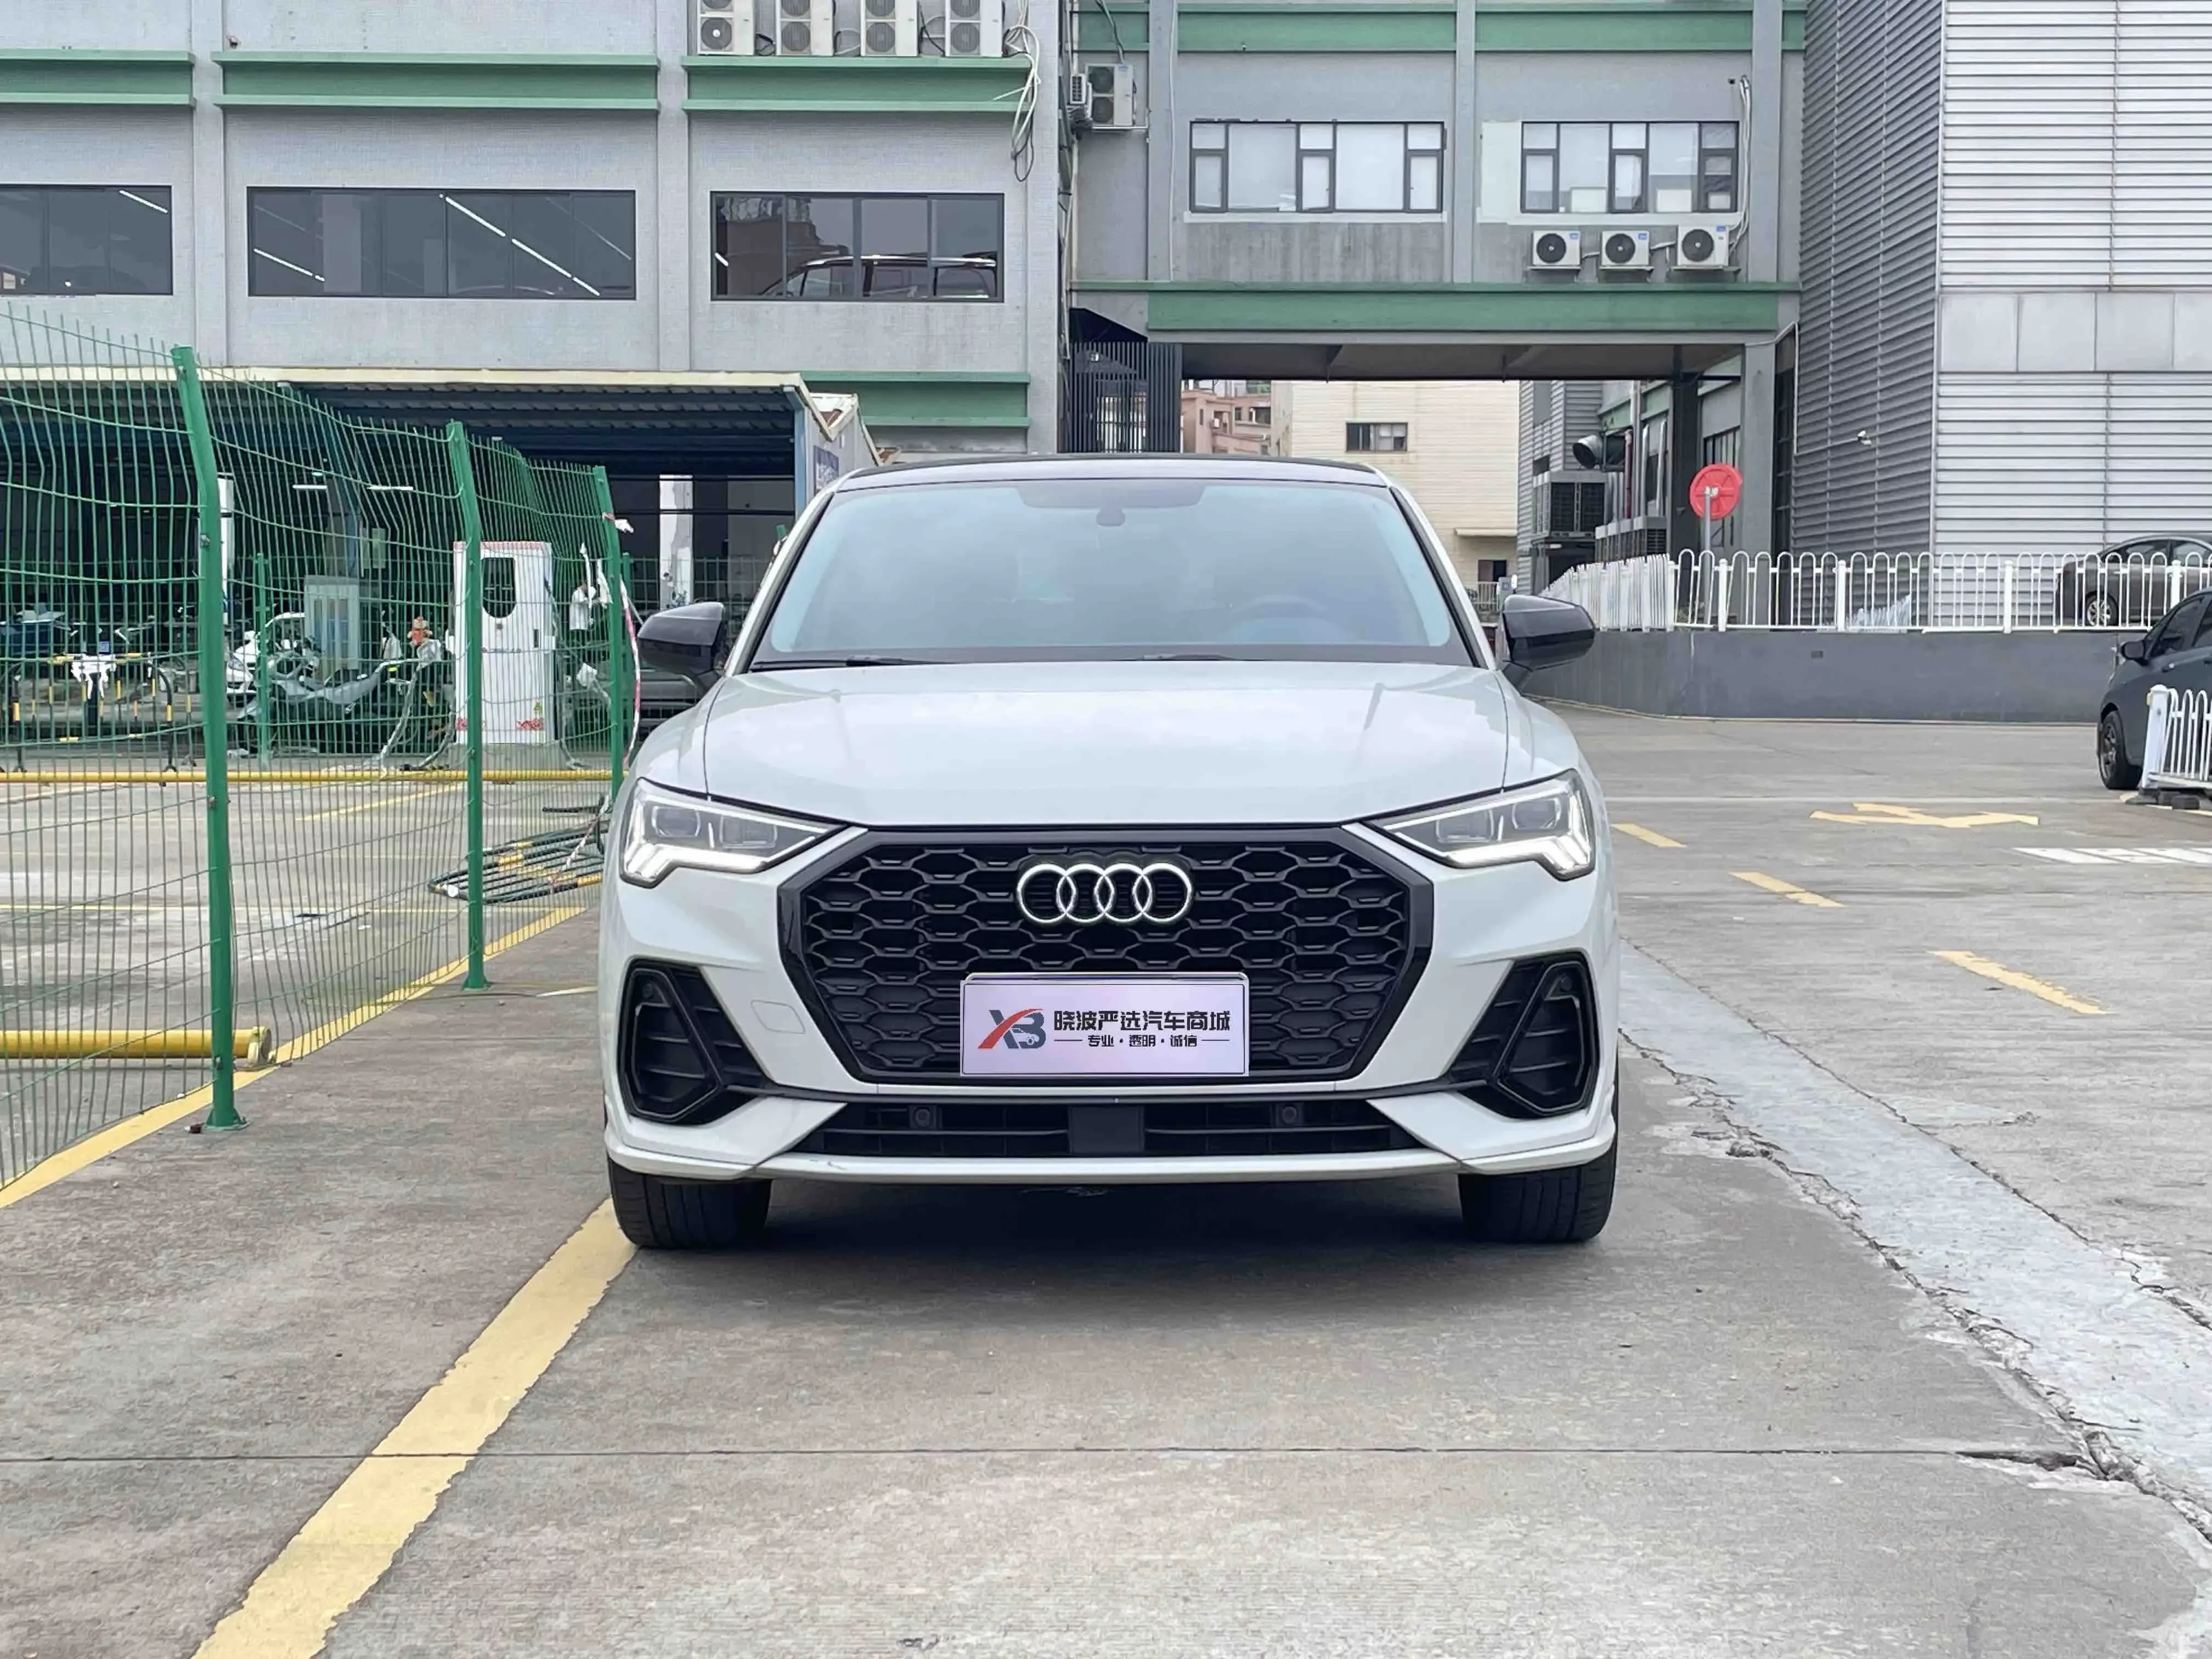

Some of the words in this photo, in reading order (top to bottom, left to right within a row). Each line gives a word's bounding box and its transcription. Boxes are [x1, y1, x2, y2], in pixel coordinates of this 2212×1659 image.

[1053, 1010, 1231, 1031] 晓波严选汽车商城
